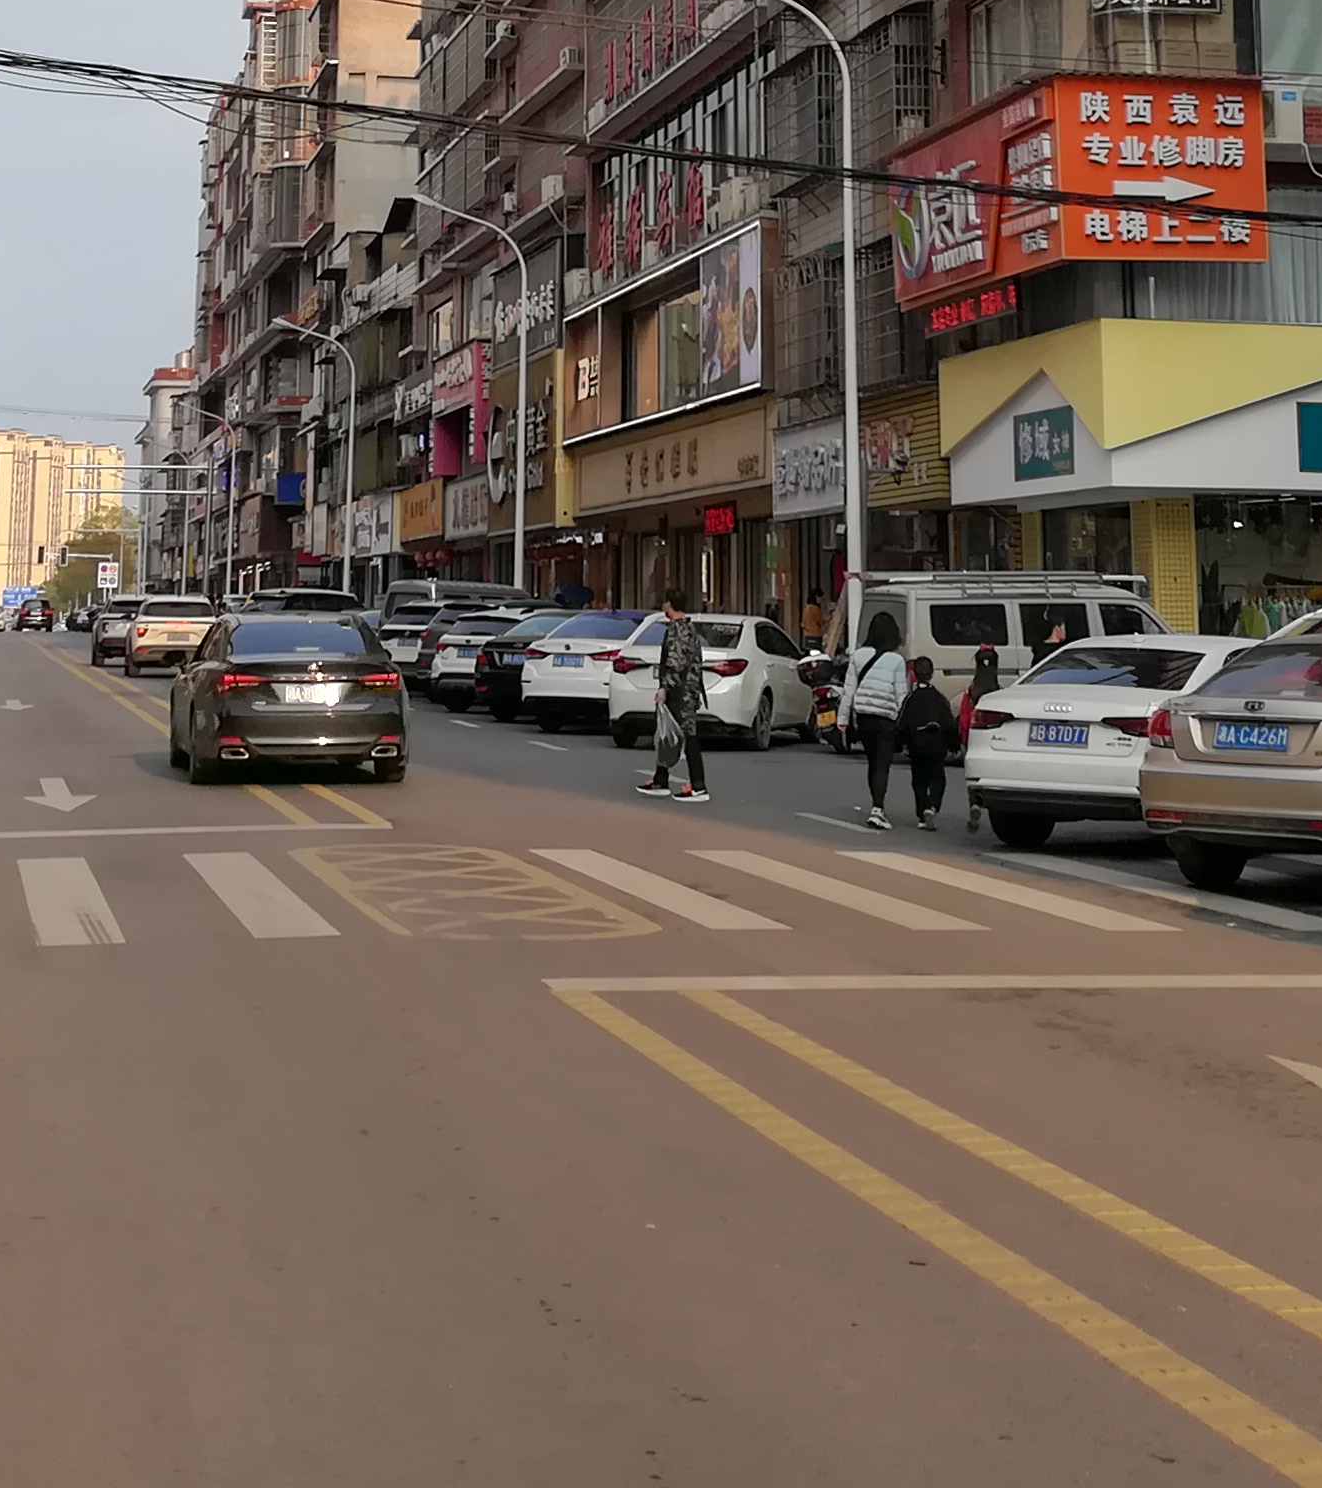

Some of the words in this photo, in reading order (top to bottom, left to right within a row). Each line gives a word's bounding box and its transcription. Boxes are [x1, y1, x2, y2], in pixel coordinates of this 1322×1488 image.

[1079, 91, 1246, 126] 陕西袁远
[1081, 132, 1246, 168] 专业修脚房
[1083, 209, 1251, 245] 电梯上二楼
